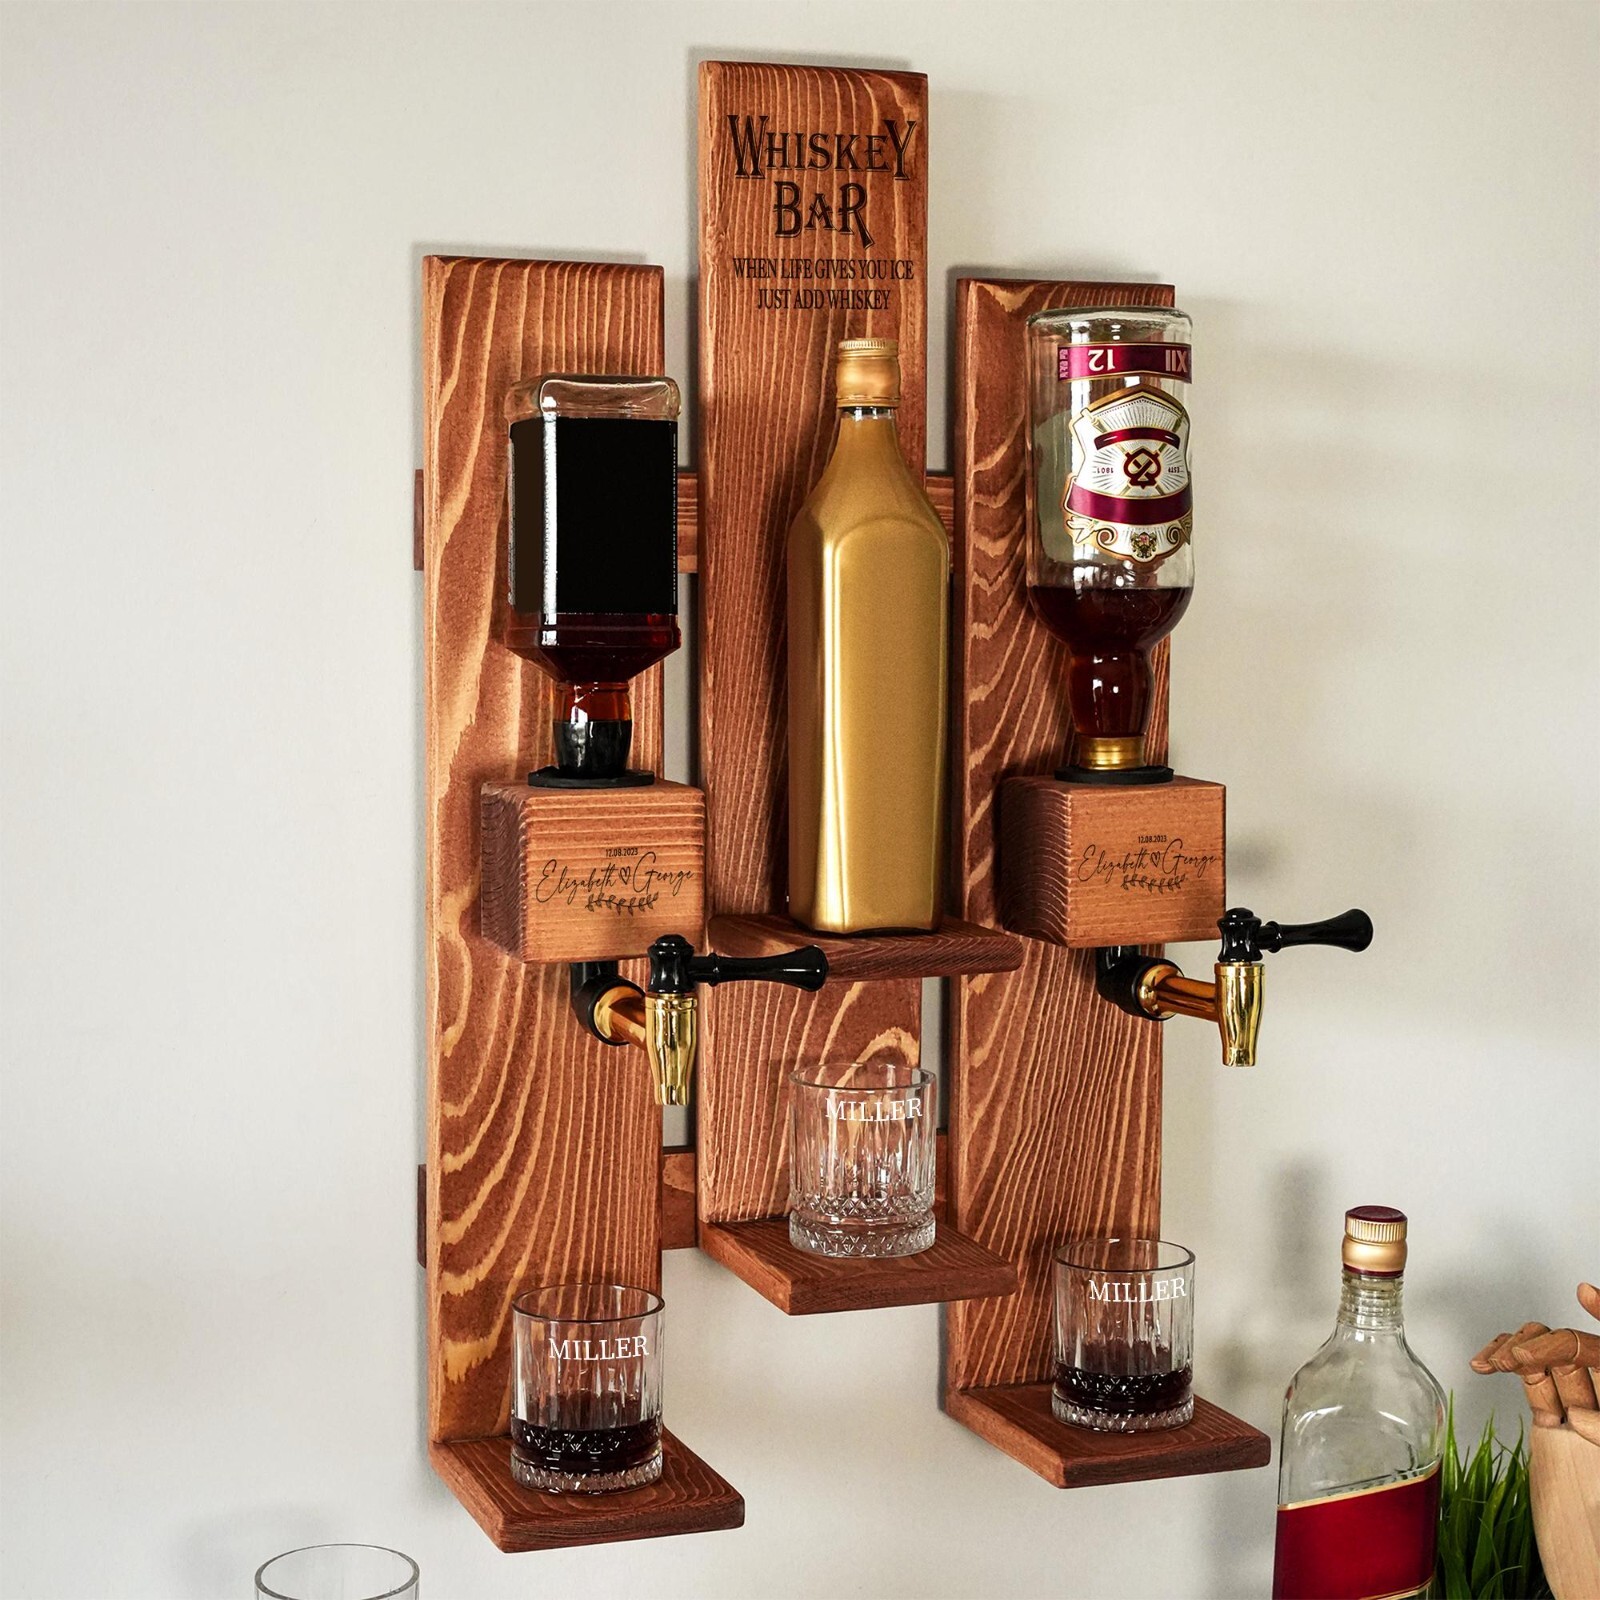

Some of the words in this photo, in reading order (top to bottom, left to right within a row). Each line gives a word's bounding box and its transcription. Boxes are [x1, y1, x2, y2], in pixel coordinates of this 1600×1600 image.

[727, 114, 917, 180] WHISKEY
[773, 181, 875, 250] BAR
[733, 257, 777, 279] WHEN
[781, 258, 812, 279] LIFE
[815, 258, 856, 279] GIVES
[858, 259, 887, 280] YOU
[890, 260, 914, 280] ICE
[758, 288, 791, 310] JUST
[795, 289, 825, 310] ADD
[826, 289, 891, 310] WHISKEY
[1087, 348, 1115, 372] 12
[1165, 349, 1188, 373] XII
[1096, 466, 1114, 474] 1801
[1138, 835, 1168, 844] 12.08.2023
[605, 847, 638, 858] 12.08.2023
[1077, 844, 1149, 884] Elizabeth
[1162, 838, 1217, 878] George
[536, 859, 618, 905] Elizabeth
[633, 851, 694, 897] George
[825, 1097, 923, 1122] MILLER
[1088, 1277, 1187, 1302] MILLER
[549, 1335, 649, 1361] MILLER
